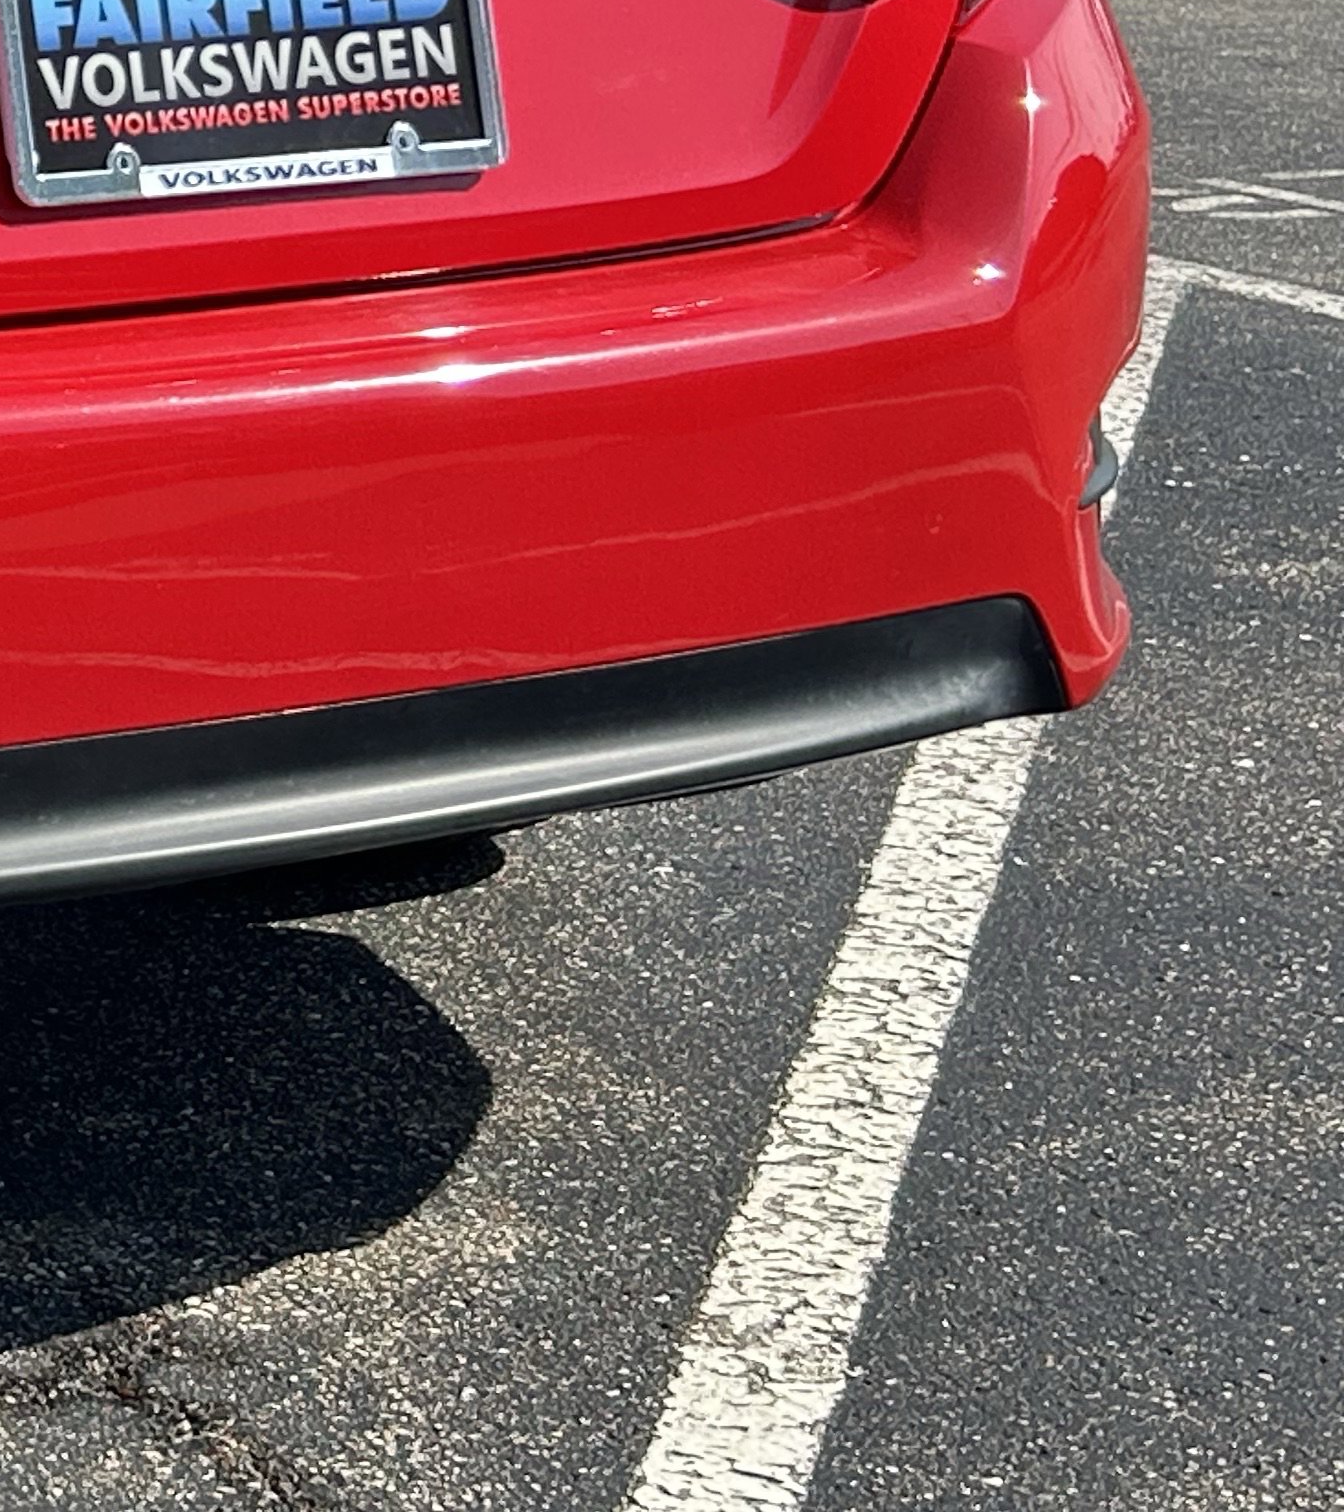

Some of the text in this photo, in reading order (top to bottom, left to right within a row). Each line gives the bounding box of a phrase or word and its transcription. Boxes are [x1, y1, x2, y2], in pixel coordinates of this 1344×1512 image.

[37, 23, 457, 111] VOLKSWAGEN
[45, 83, 462, 143] THE VOLKSWAGEN SUPERSTORE
[158, 157, 379, 189] VOLKSWAGEN
